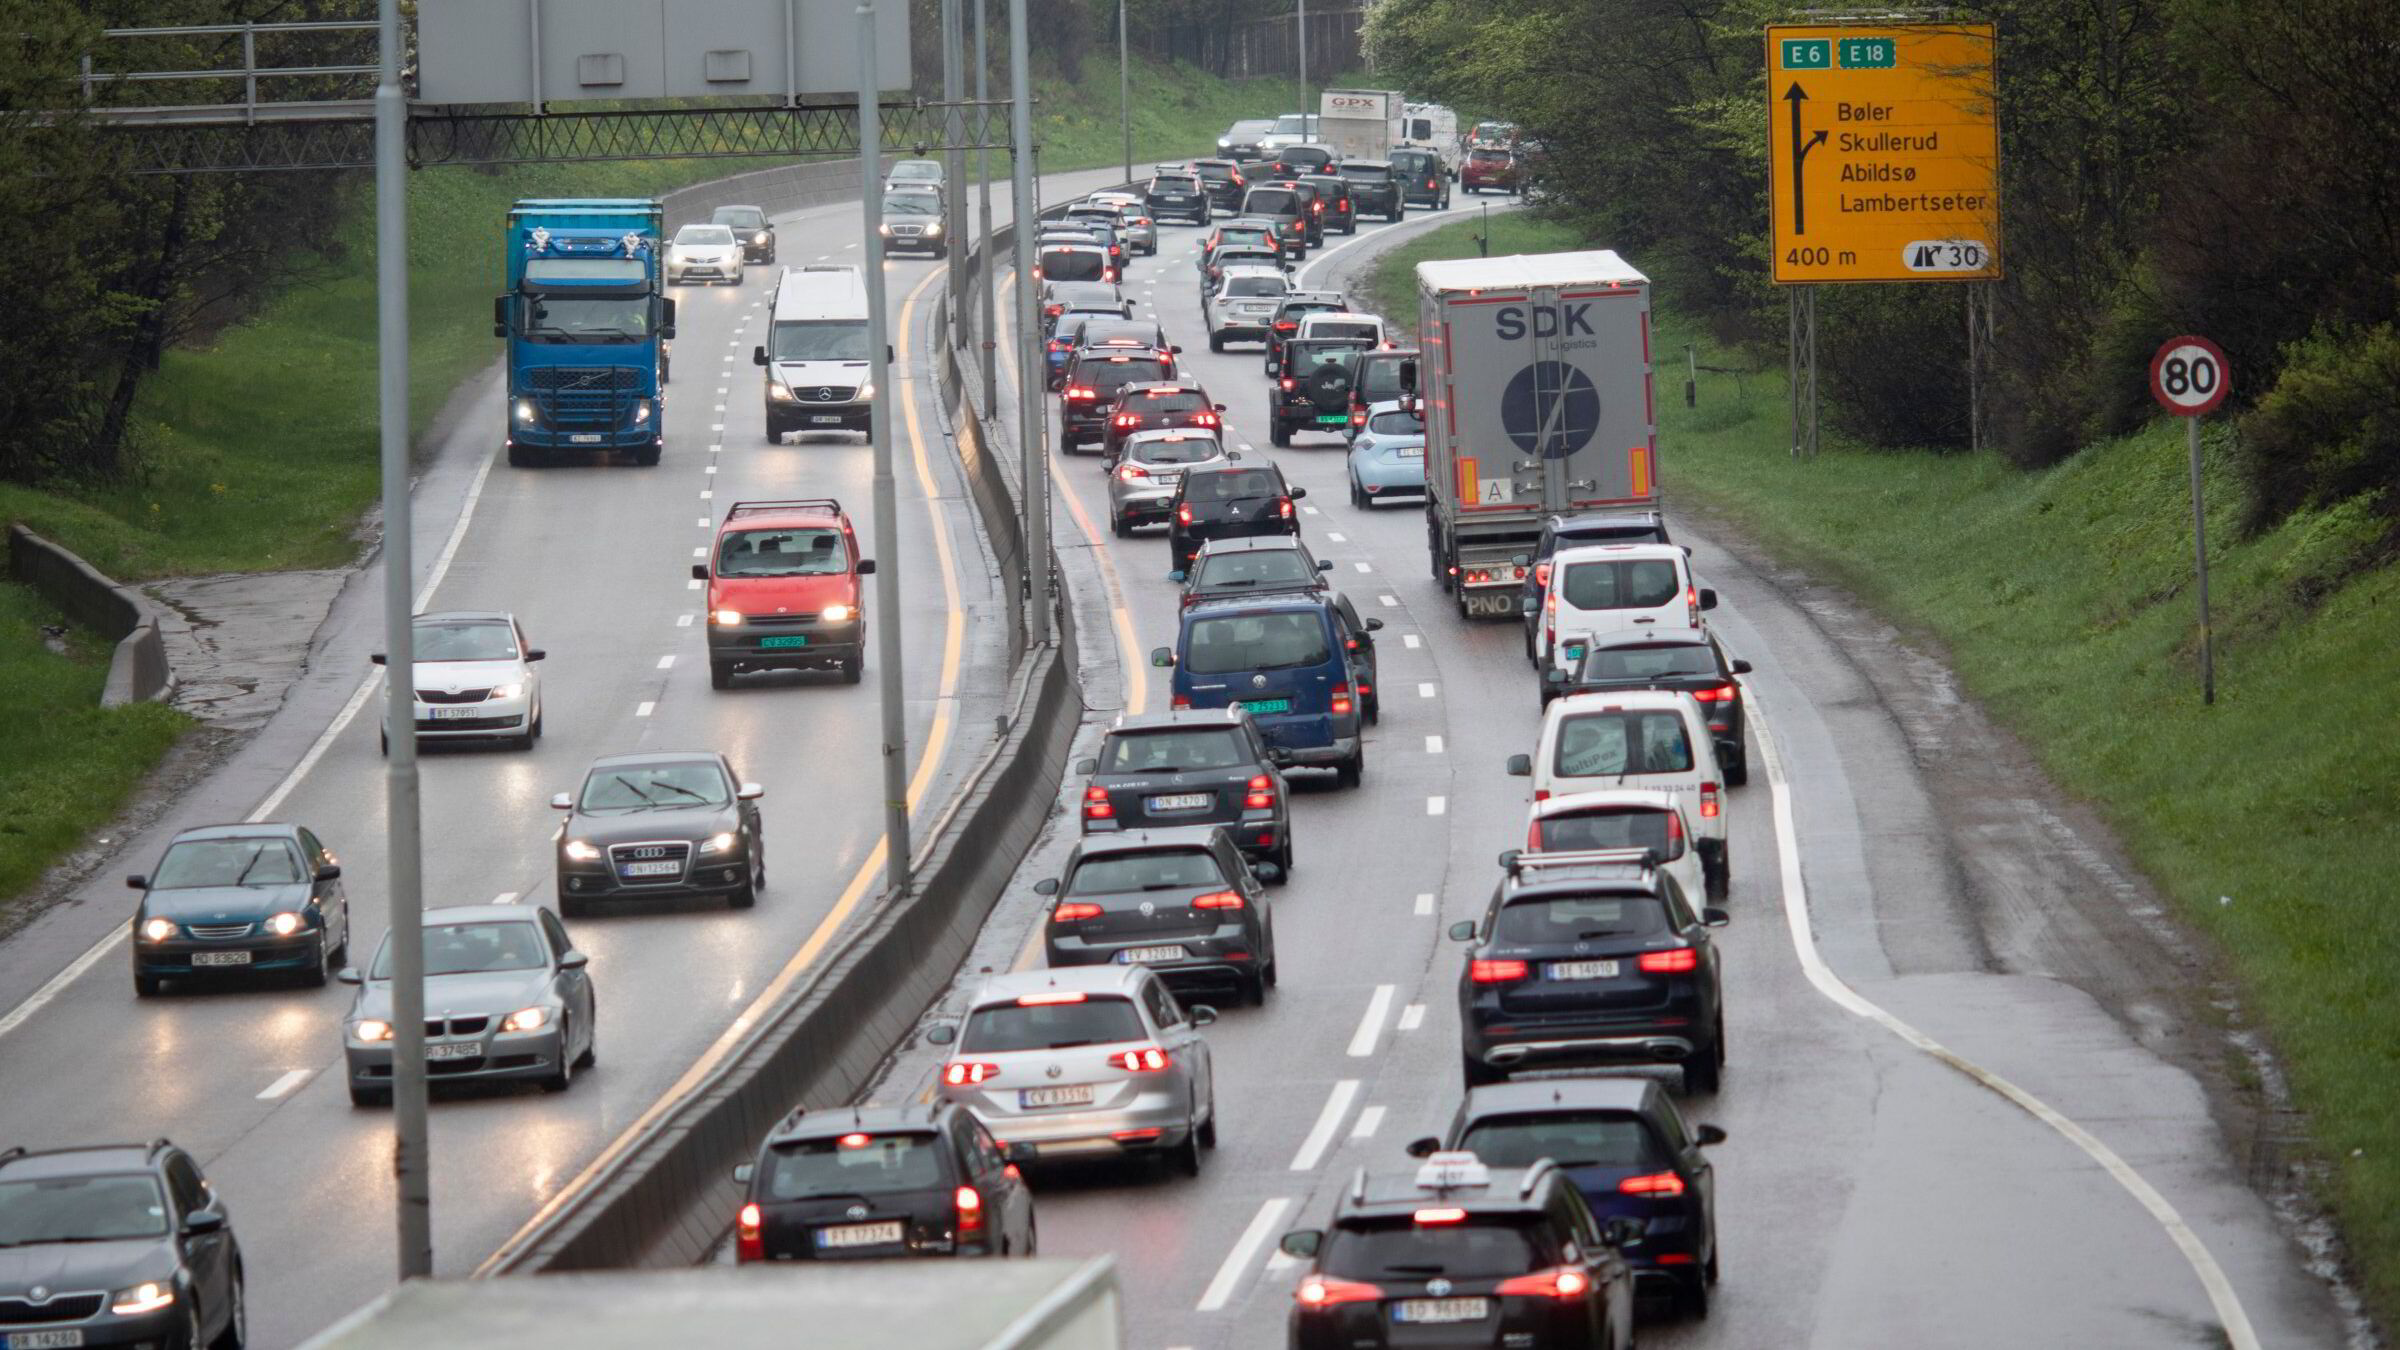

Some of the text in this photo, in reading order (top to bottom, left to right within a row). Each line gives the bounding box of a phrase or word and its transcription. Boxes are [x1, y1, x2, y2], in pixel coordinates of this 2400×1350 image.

[1791, 46, 1821, 63] E 6
[1850, 45, 1884, 62] E 18
[1331, 97, 1375, 107] GPX
[1838, 102, 1894, 121] Bøler
[1839, 132, 1938, 152] Skullerud
[1840, 163, 1917, 182] Abildsø
[1840, 193, 1986, 213] Lambertseter
[1786, 247, 1857, 266] 400 m
[1949, 246, 1979, 267] 30
[1496, 303, 1595, 341] SDK
[2165, 357, 2216, 396] 80
[1488, 480, 1502, 501] A
[1467, 595, 1512, 614] PNO
